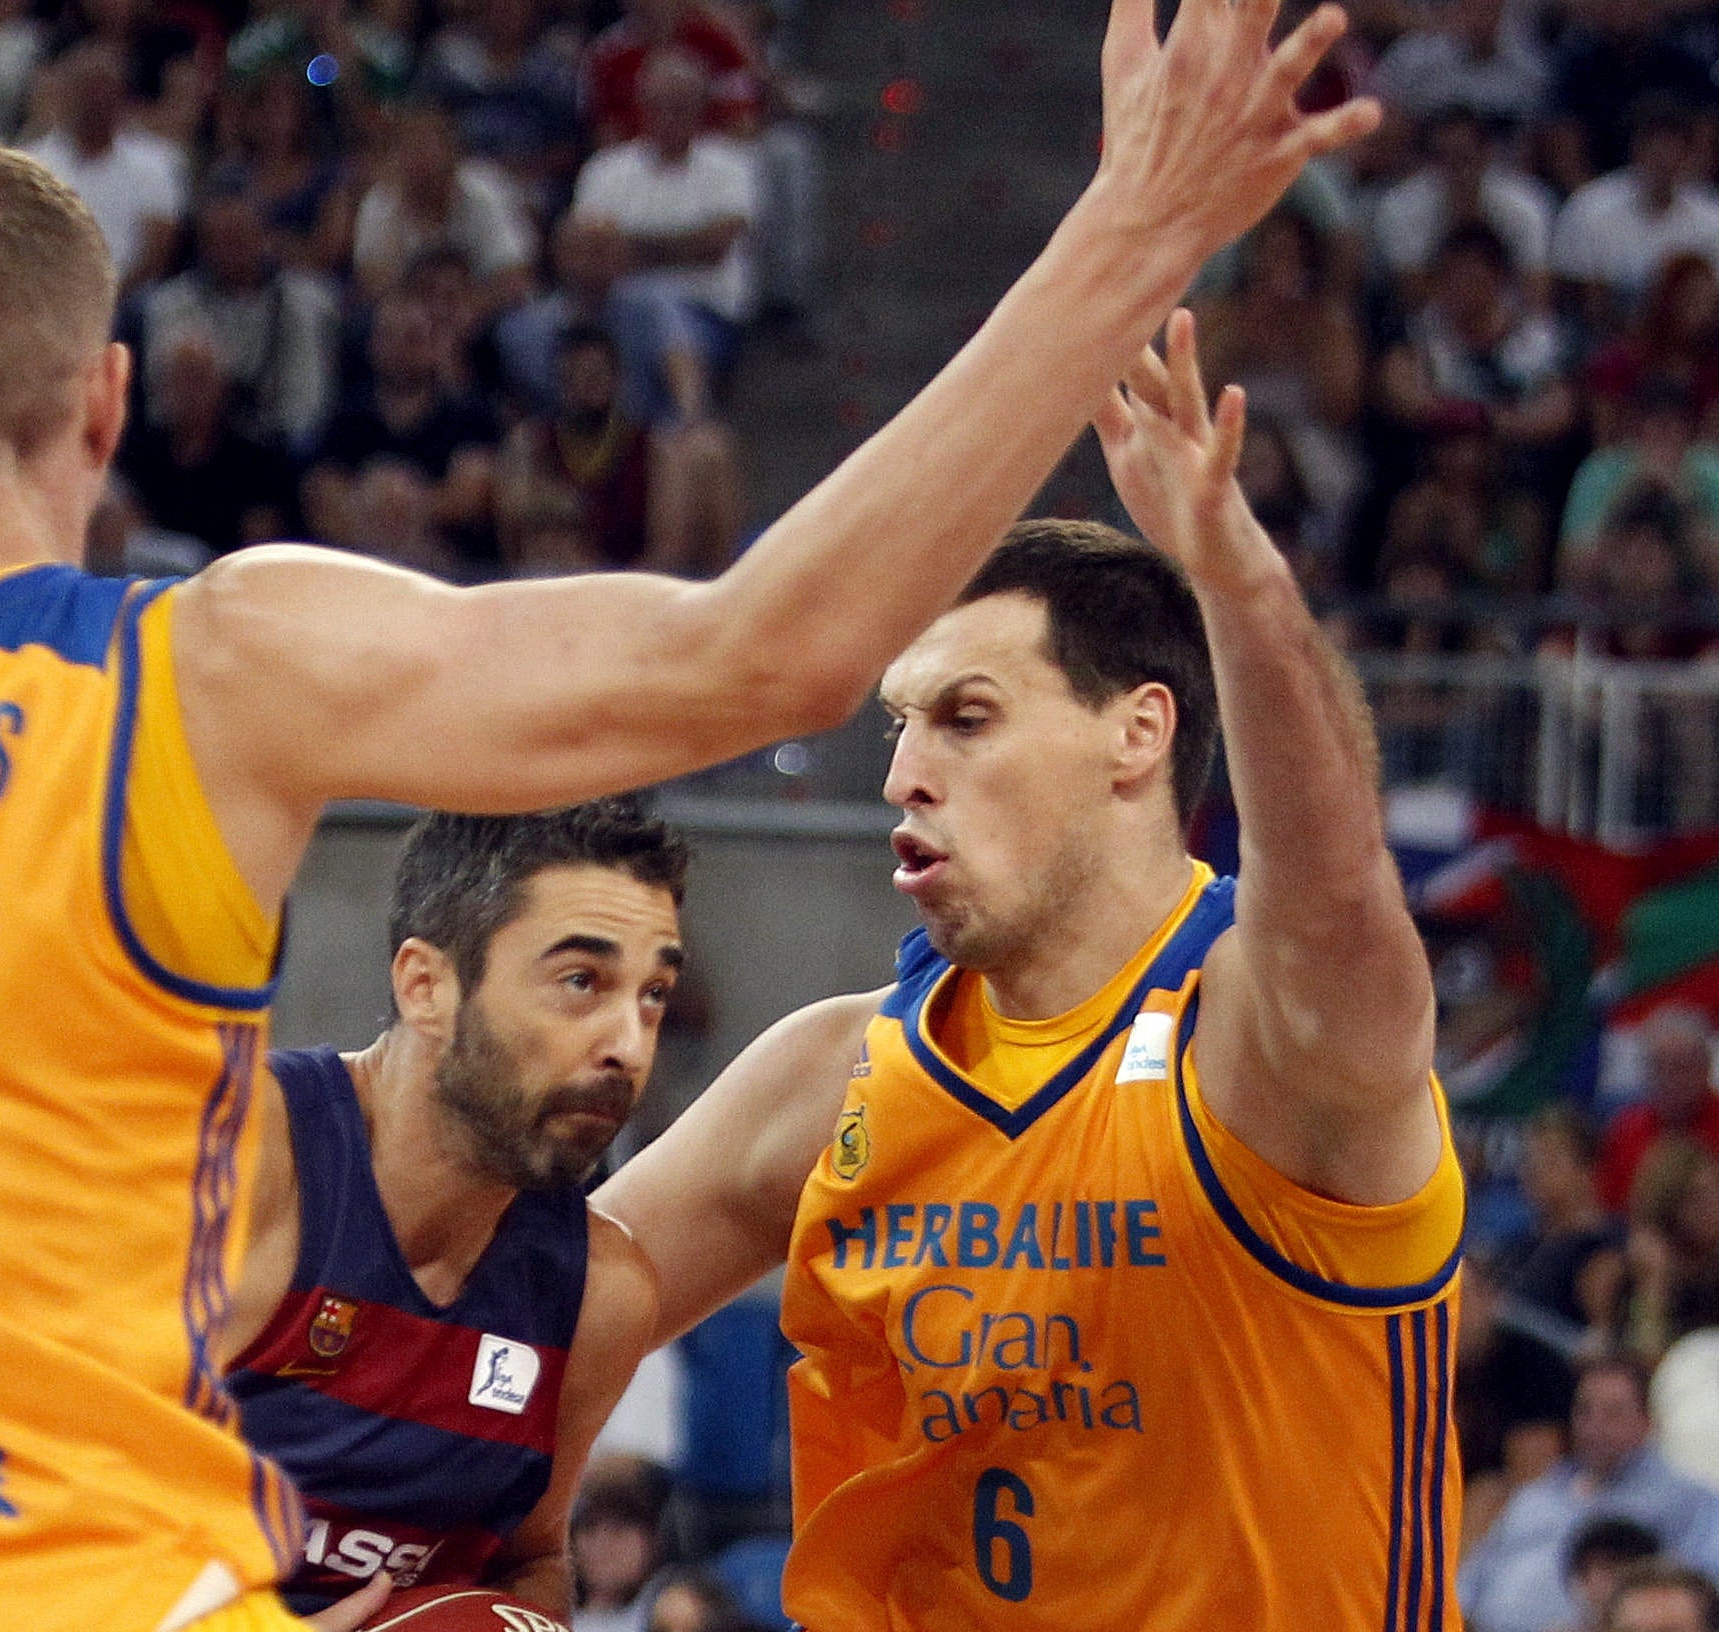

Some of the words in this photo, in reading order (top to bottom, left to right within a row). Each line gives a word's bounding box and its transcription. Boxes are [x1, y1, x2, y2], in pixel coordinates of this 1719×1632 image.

[826, 1200, 1166, 1270] HERBALIFE
[902, 1284, 1081, 1370] Gran
[919, 1362, 1144, 1443] anaria
[972, 1467, 1035, 1602] 6
